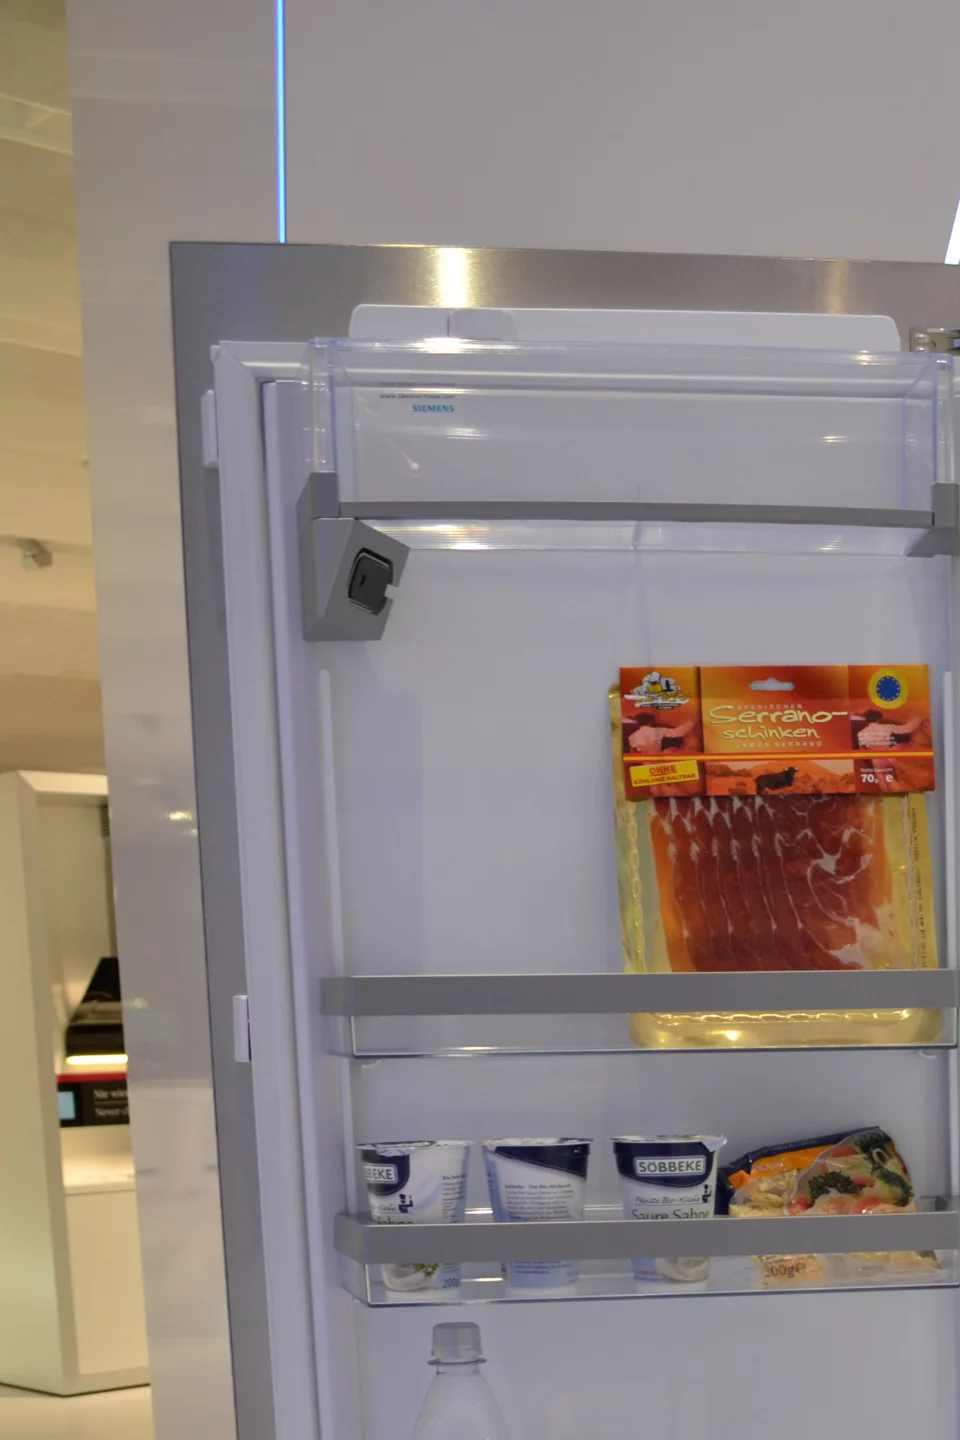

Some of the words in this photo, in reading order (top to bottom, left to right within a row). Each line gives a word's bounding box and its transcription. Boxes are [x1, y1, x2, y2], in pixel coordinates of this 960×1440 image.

[412, 404, 455, 412] SIEMENS
[709, 704, 848, 724] Serrano-
[723, 725, 820, 740] schinken
[775, 740, 823, 748] SERRANO
[649, 764, 677, 775] OHNE
[639, 1160, 702, 1173] SÖBBEKE
